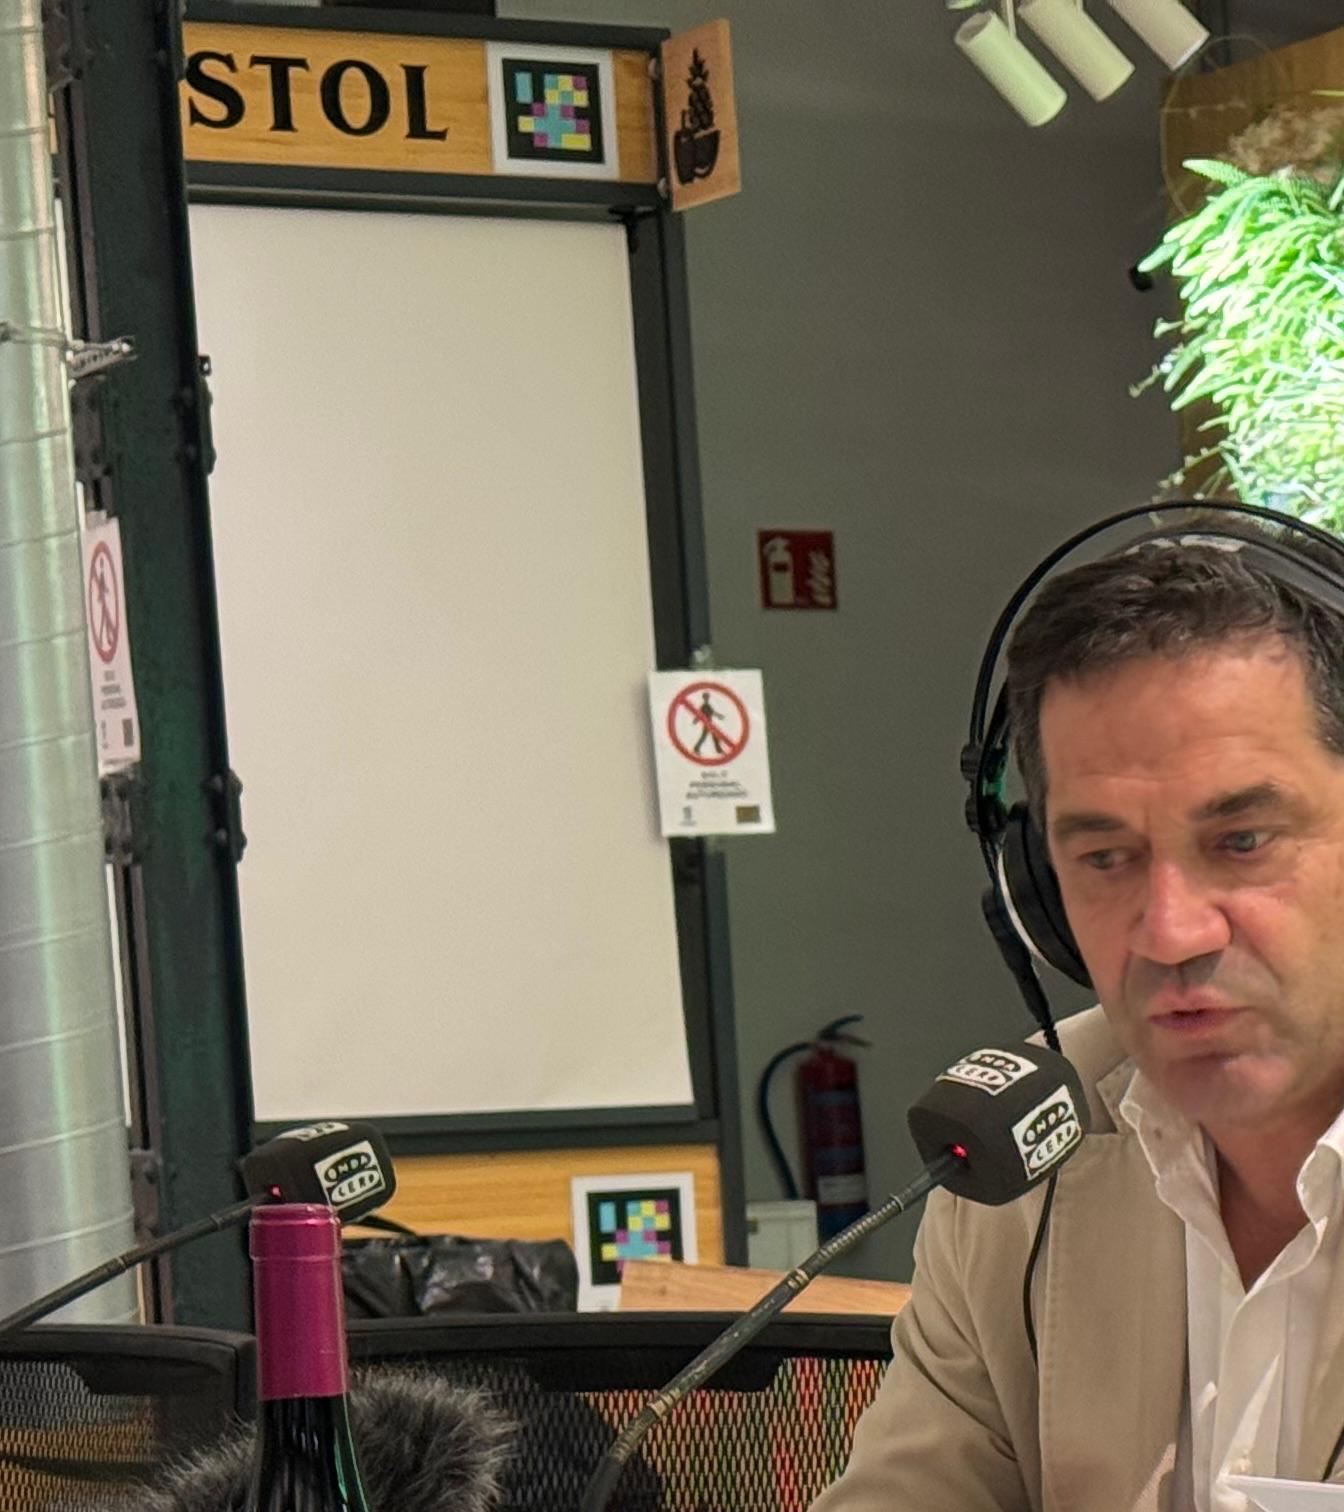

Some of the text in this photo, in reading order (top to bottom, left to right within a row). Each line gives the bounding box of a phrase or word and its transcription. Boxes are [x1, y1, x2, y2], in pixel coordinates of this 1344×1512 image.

[956, 1066, 998, 1082] CERO
[968, 1053, 1016, 1073] ONDA
[1026, 1104, 1068, 1142] ONDA
[1036, 1125, 1072, 1161] CERO
[327, 1154, 371, 1180] ONDA
[337, 1173, 376, 1198] CERO
